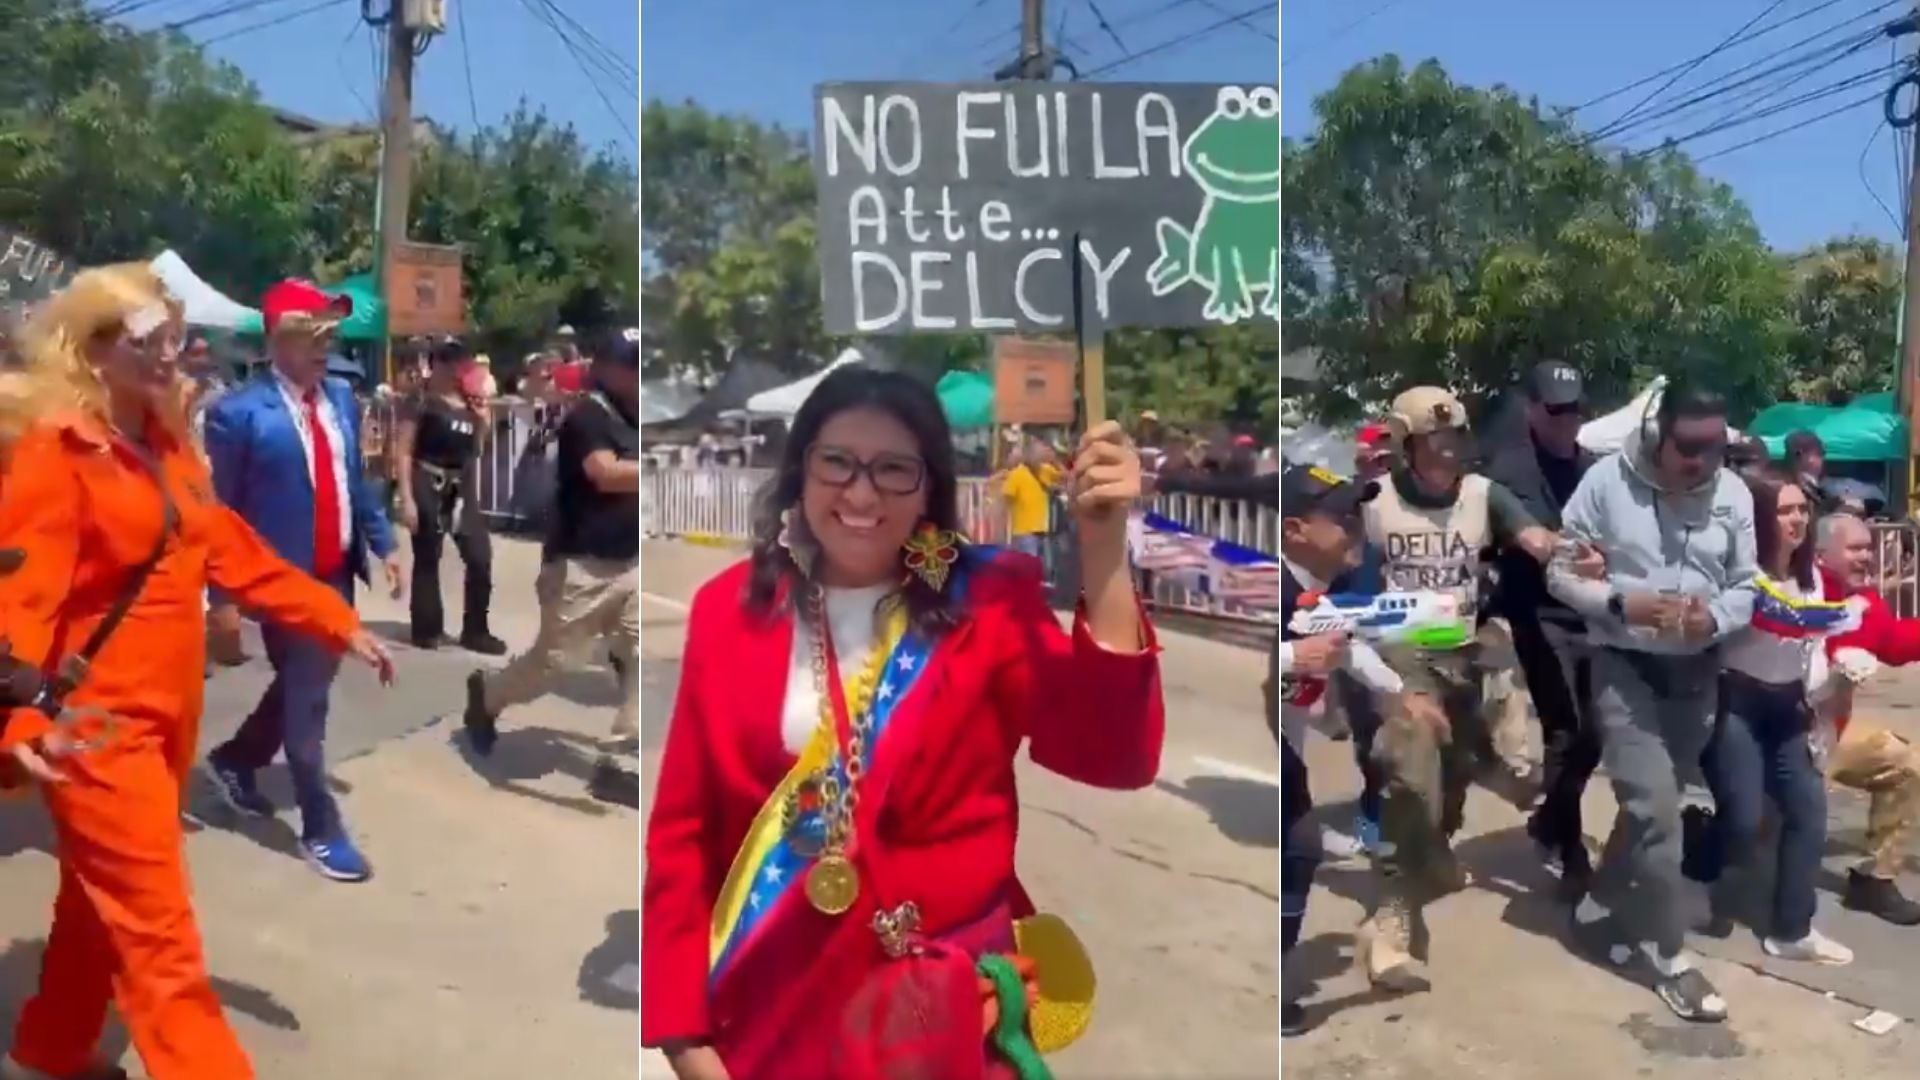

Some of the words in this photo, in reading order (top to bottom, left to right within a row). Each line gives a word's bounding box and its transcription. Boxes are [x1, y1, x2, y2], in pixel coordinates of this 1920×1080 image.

[823, 94, 922, 177] NO
[957, 91, 1070, 179] FUI
[1092, 92, 1181, 178] LA
[851, 240, 1131, 331] DELCY
[1387, 530, 1470, 558] DELTA
